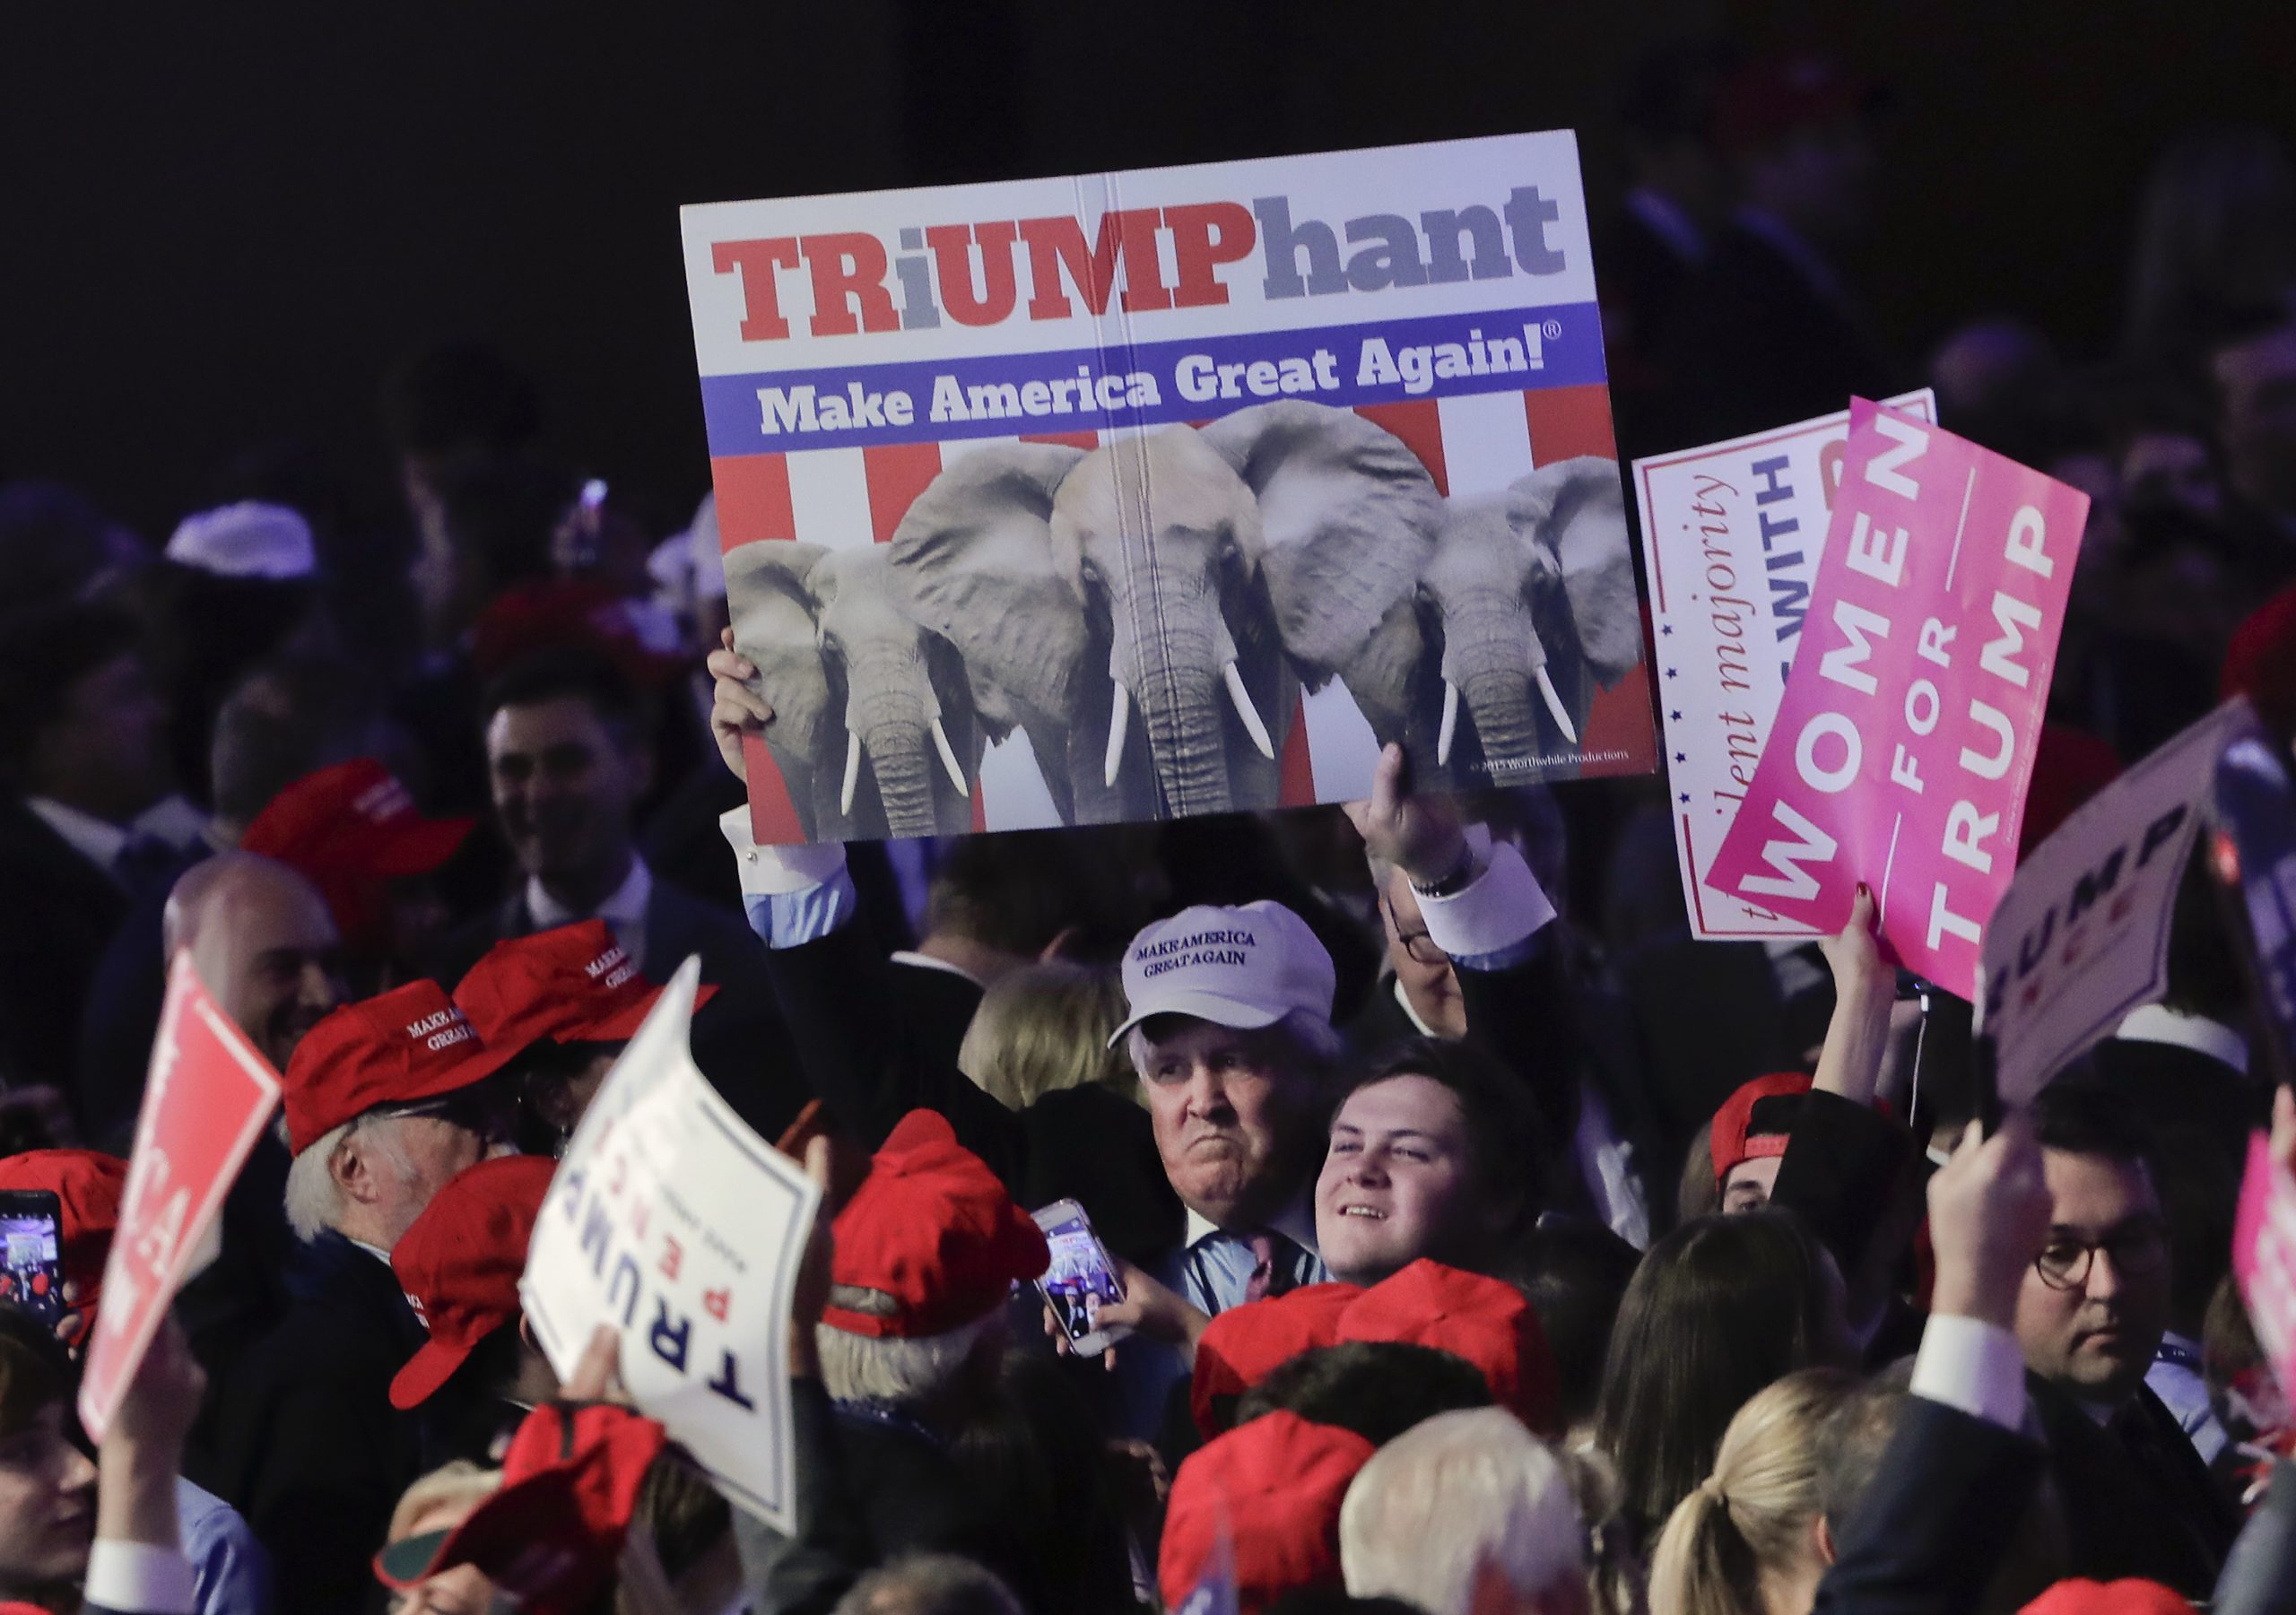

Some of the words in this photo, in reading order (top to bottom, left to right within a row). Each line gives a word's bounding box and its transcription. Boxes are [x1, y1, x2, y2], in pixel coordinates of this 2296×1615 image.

[710, 186, 1567, 342] TRiUMPhant
[756, 382, 914, 435] Make
[929, 365, 1162, 423] America
[1175, 349, 1340, 403] Great
[1682, 473, 1757, 694] majority
[1751, 455, 1810, 643] WITH
[1737, 412, 1930, 901] WOMEN
[1891, 616, 1957, 794] FOR
[1926, 505, 2056, 951] TRUMP
[1507, 752, 1565, 771] Worthwhile
[1569, 750, 1629, 764] Productions
[1144, 954, 1190, 978] GREAT
[1192, 950, 1246, 966] AGAIN
[1179, 930, 1256, 950] AMERICA
